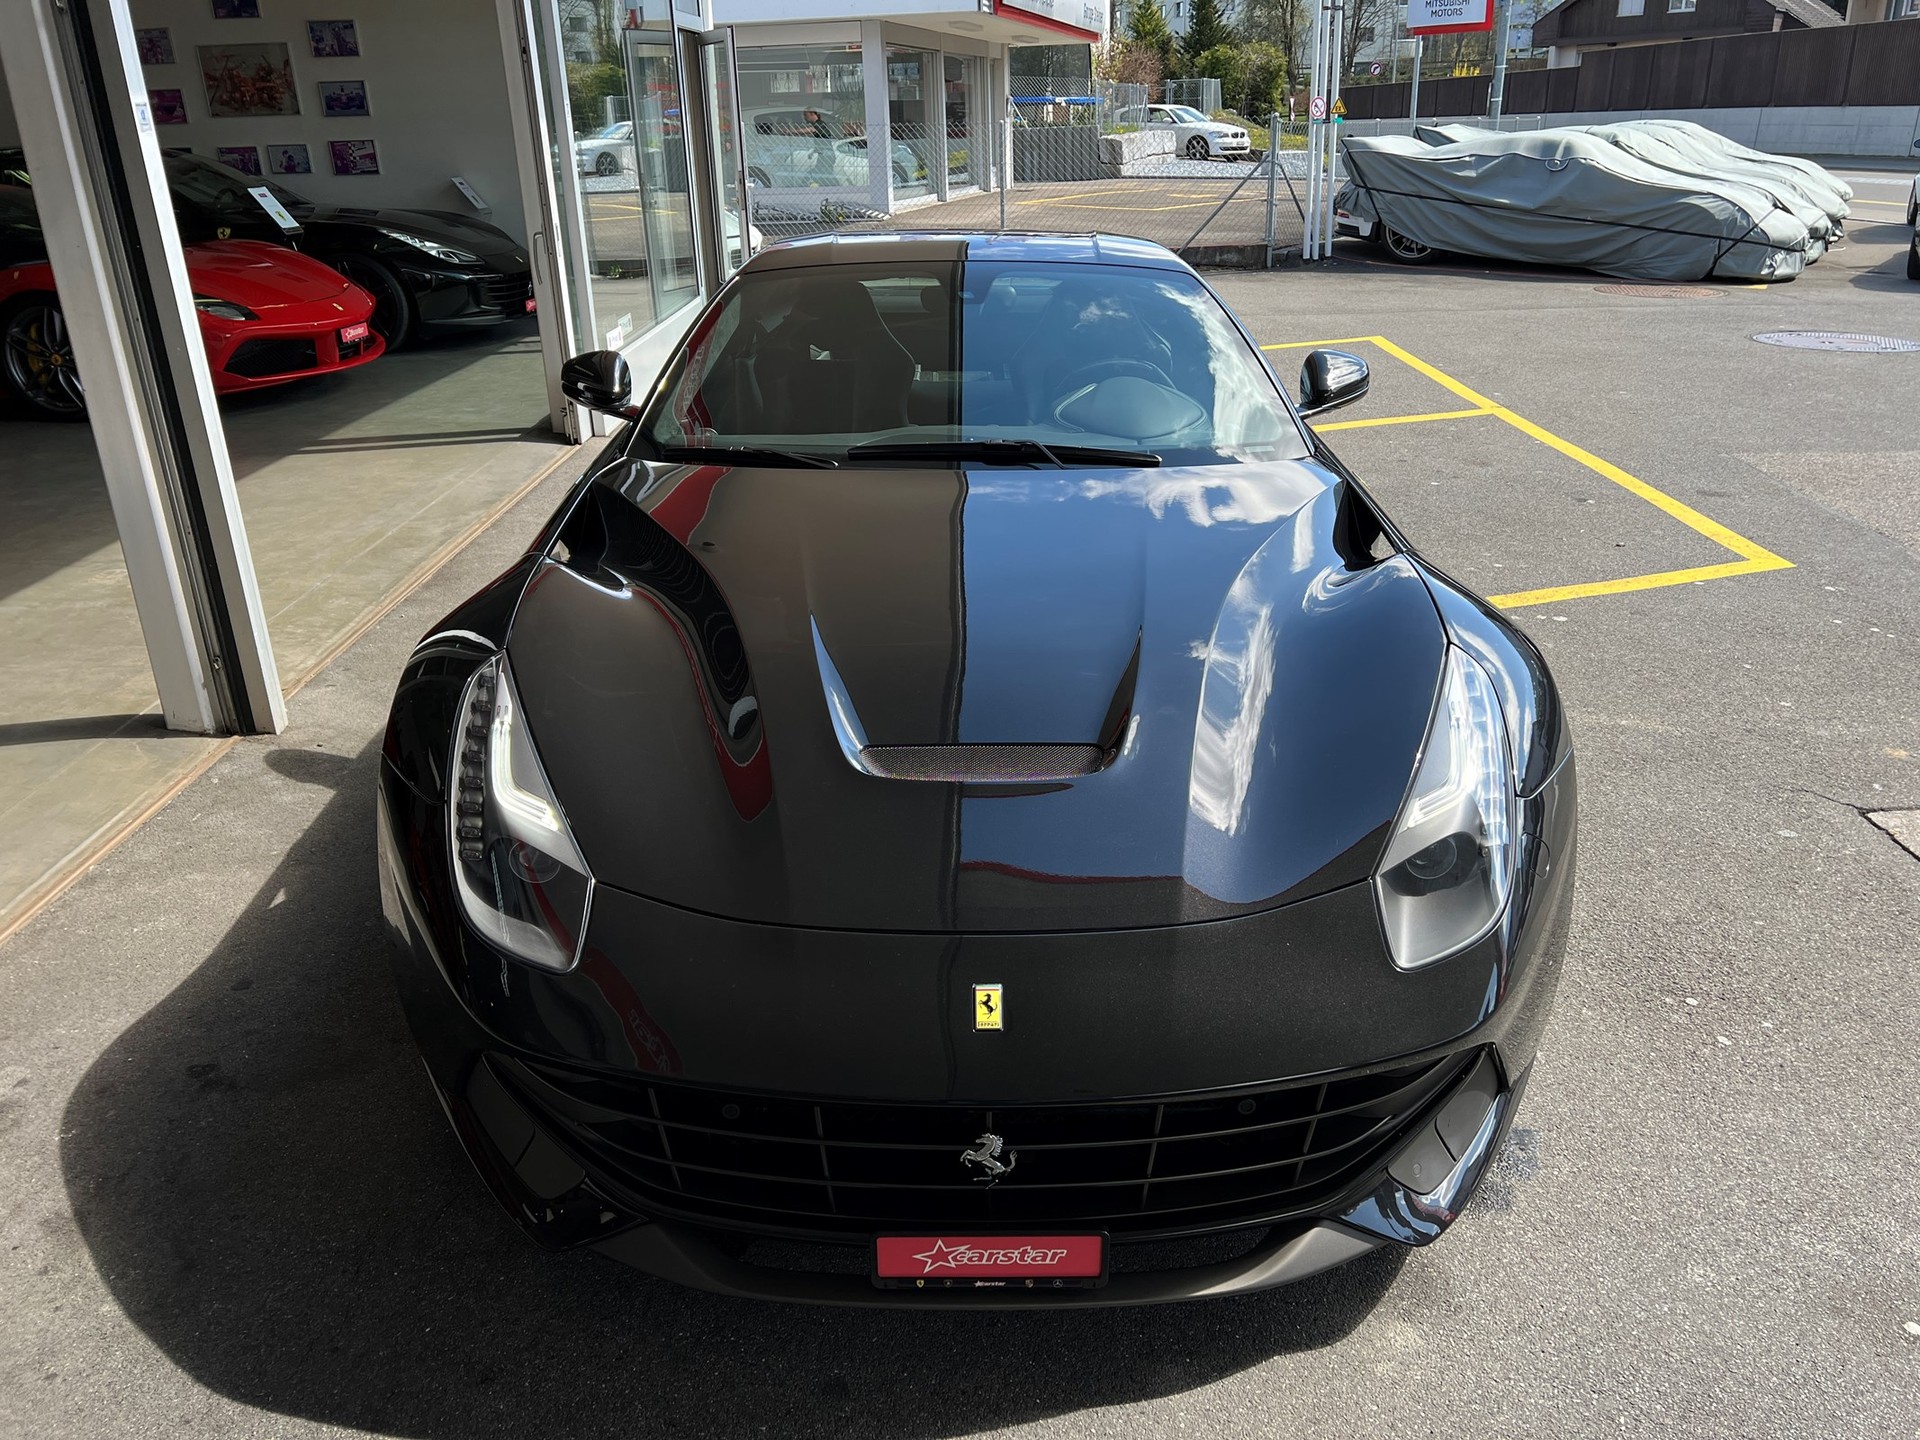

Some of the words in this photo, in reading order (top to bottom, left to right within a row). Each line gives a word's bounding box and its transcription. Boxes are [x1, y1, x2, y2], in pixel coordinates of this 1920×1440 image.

[1425, 0, 1470, 8] MITSUBISHI
[1430, 8, 1463, 18] MOTORS
[953, 1246, 1067, 1265] carstar
